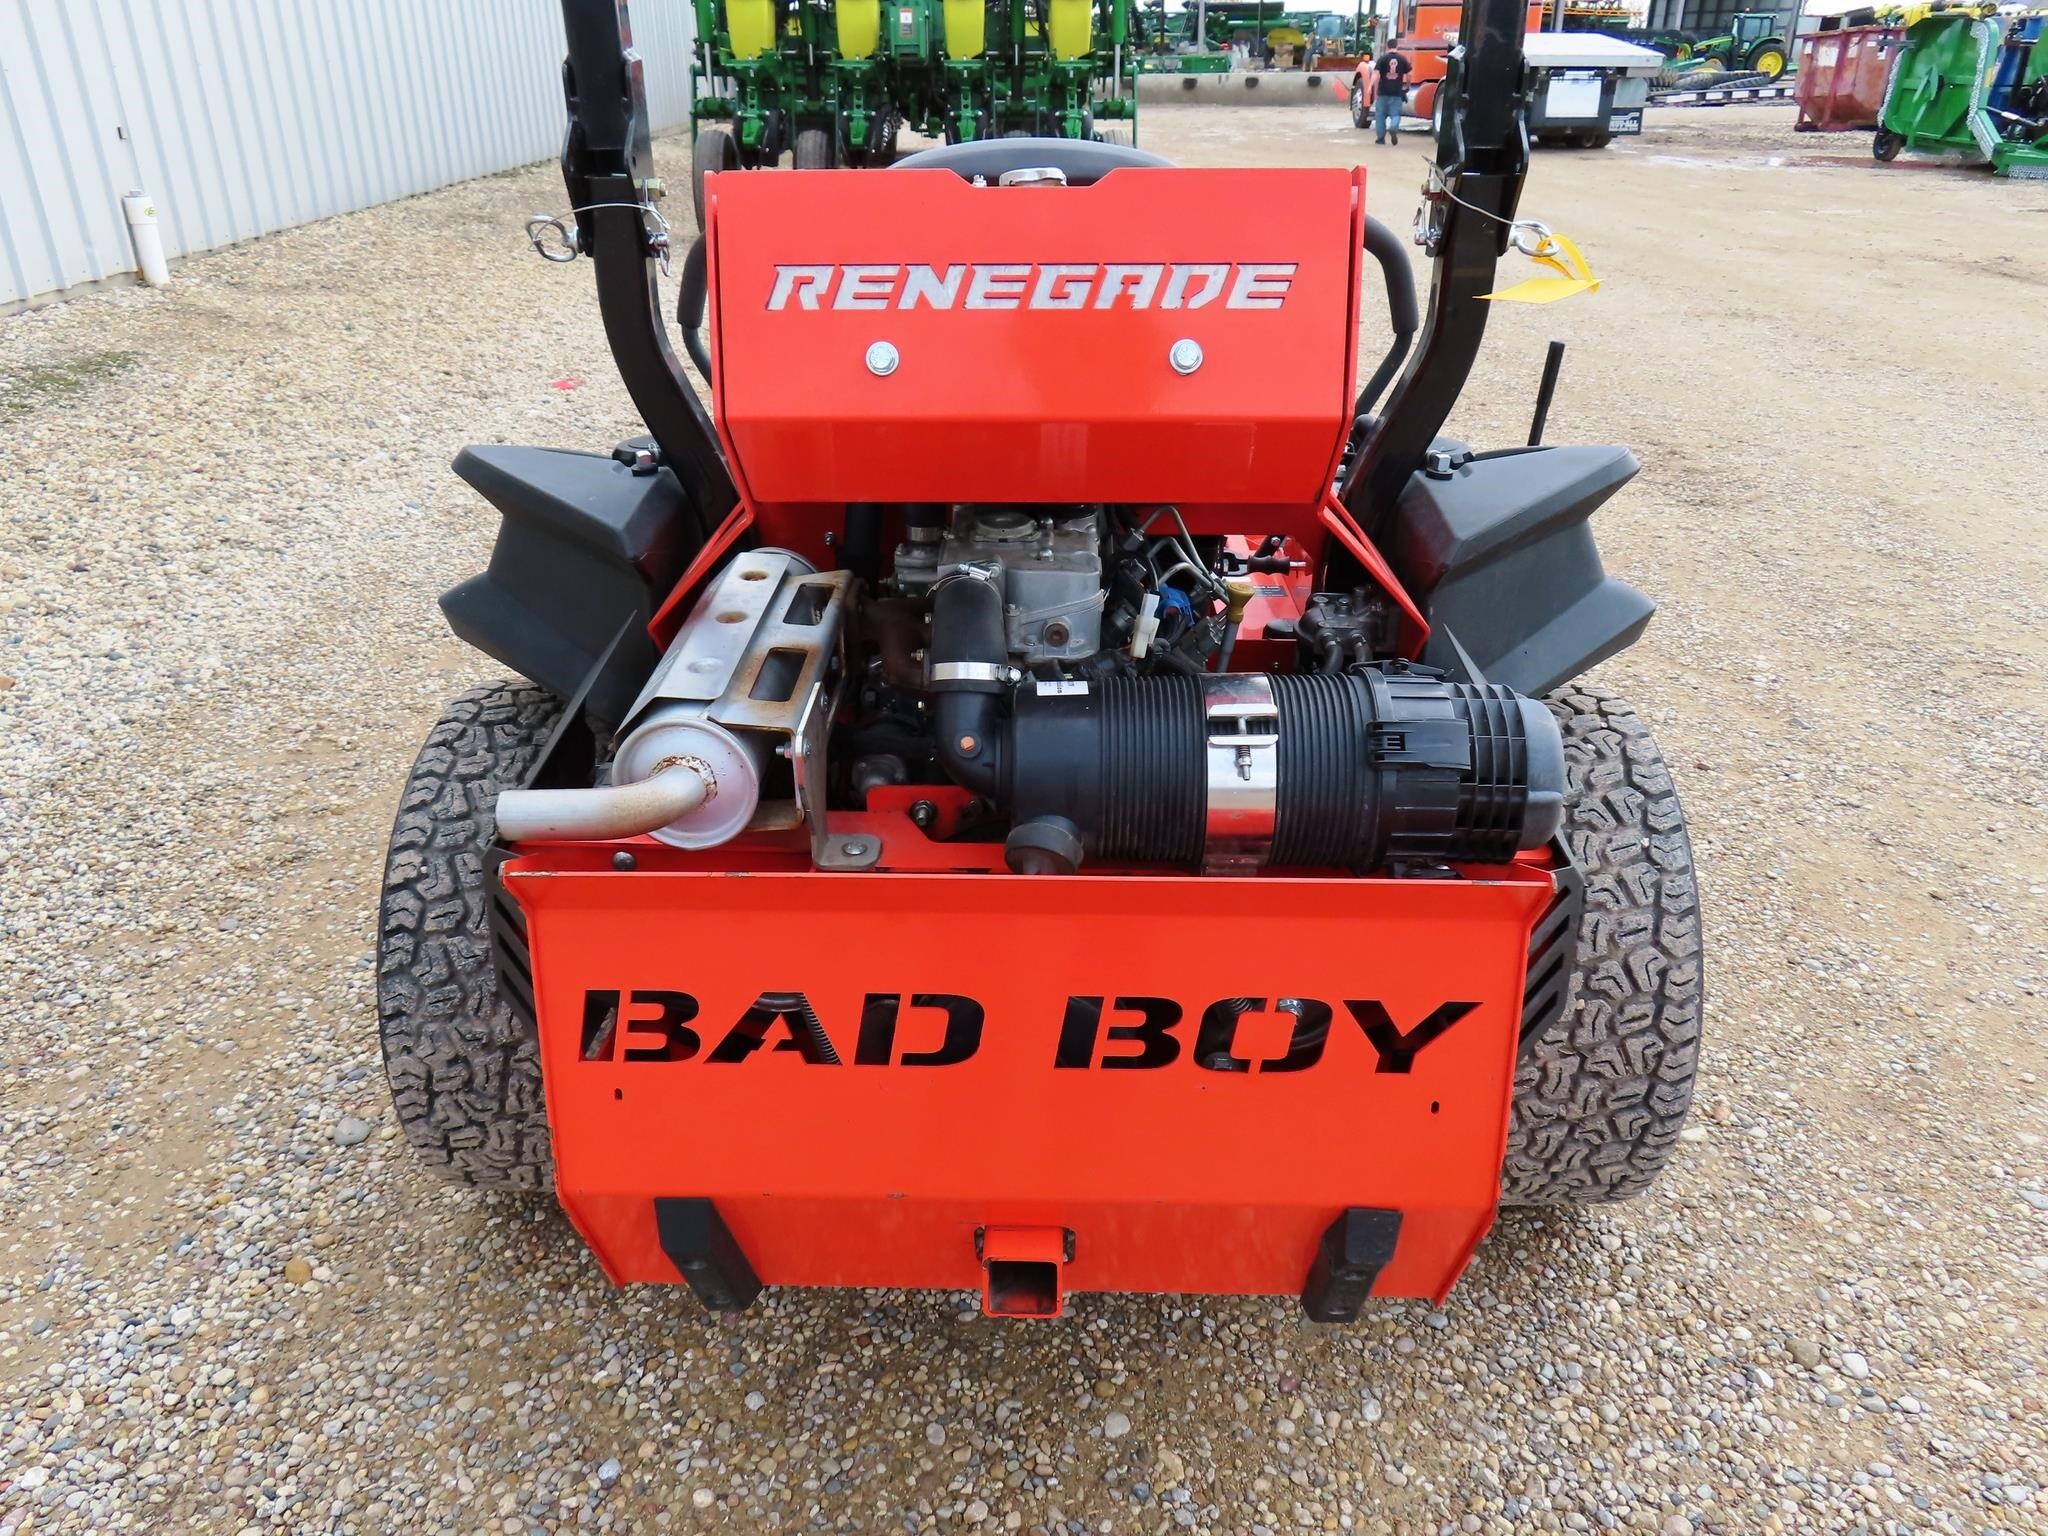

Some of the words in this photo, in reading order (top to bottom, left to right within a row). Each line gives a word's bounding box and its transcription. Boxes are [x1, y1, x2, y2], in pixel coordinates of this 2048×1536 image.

[766, 263, 1299, 310] RENEGADE
[578, 990, 985, 1066] BAD
[1054, 996, 1484, 1074] BOY
